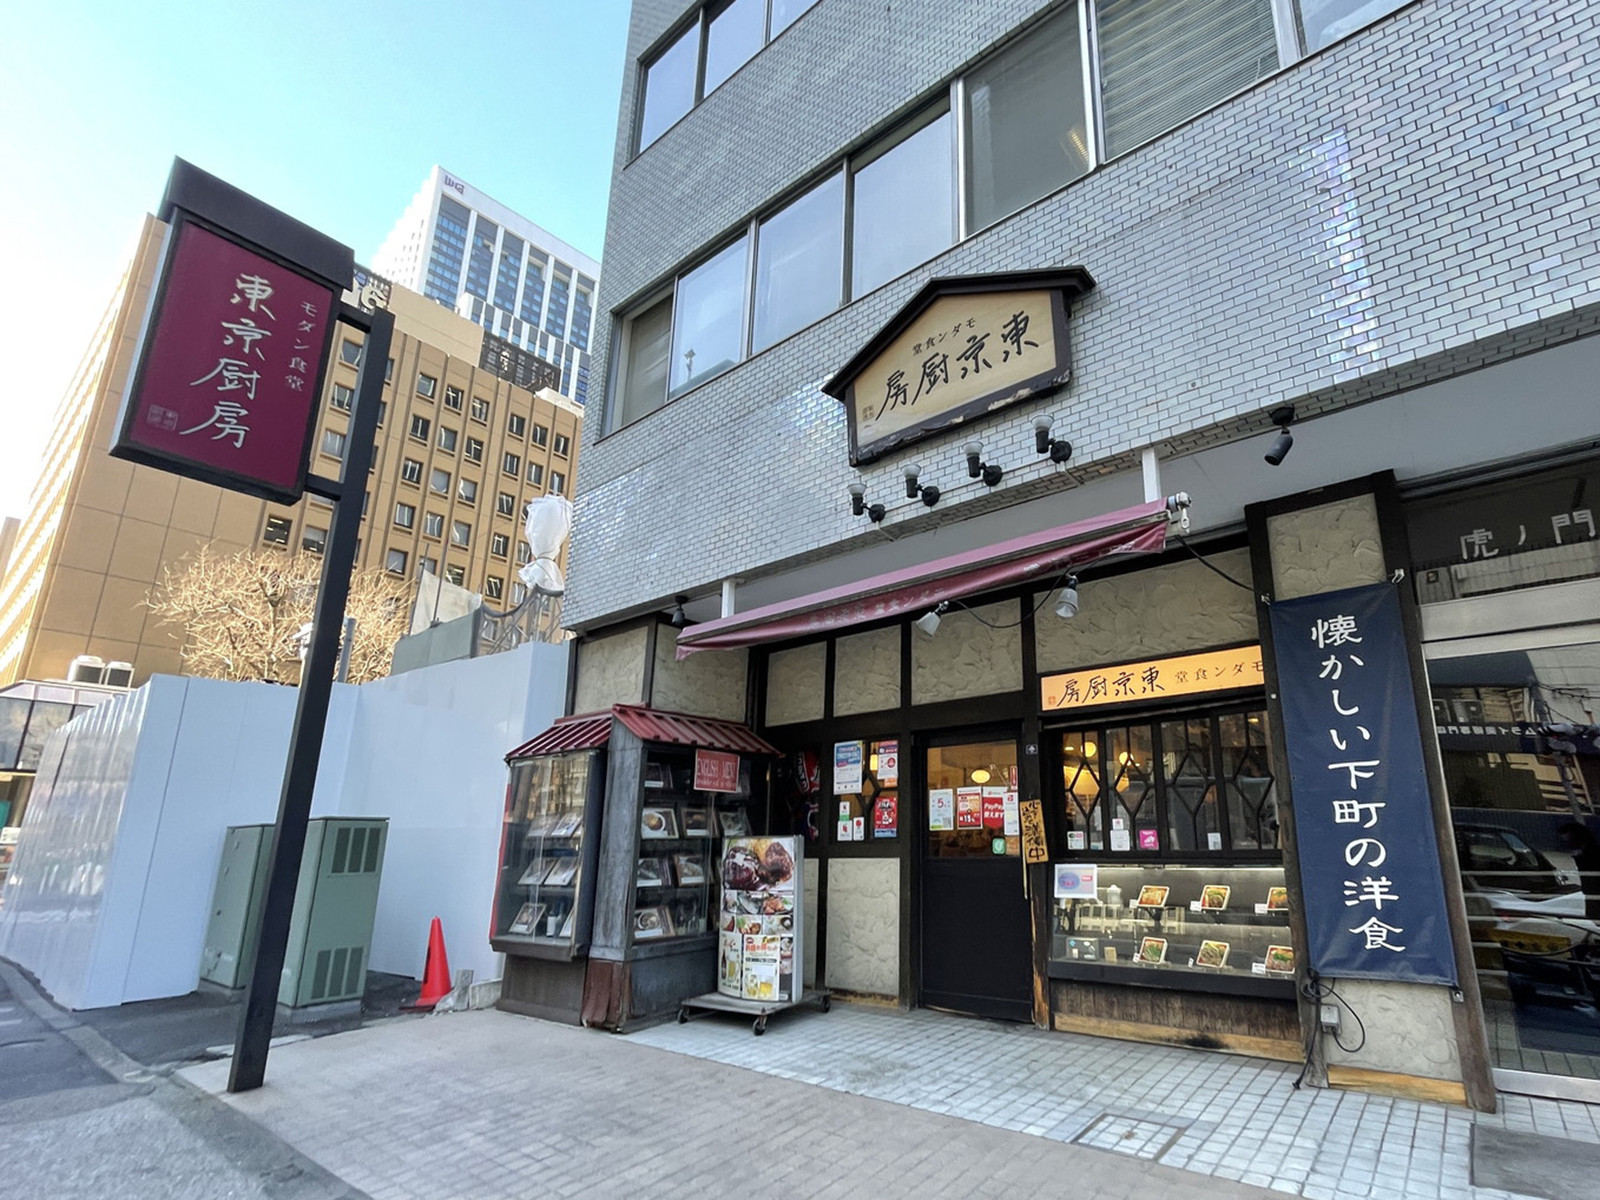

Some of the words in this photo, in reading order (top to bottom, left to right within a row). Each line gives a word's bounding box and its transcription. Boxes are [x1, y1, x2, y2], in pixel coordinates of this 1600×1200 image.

[180, 273, 275, 449] 東京厨房
[285, 300, 317, 393] モダン食堂
[875, 310, 1039, 421] 東京厨房
[912, 317, 977, 356] モダン食堂
[1460, 509, 1596, 560] 虎ノ門
[1057, 665, 1166, 707] 東京厨房
[1174, 660, 1265, 684] モダン食堂
[1310, 614, 1406, 953] 懐かしい下町の洋食
